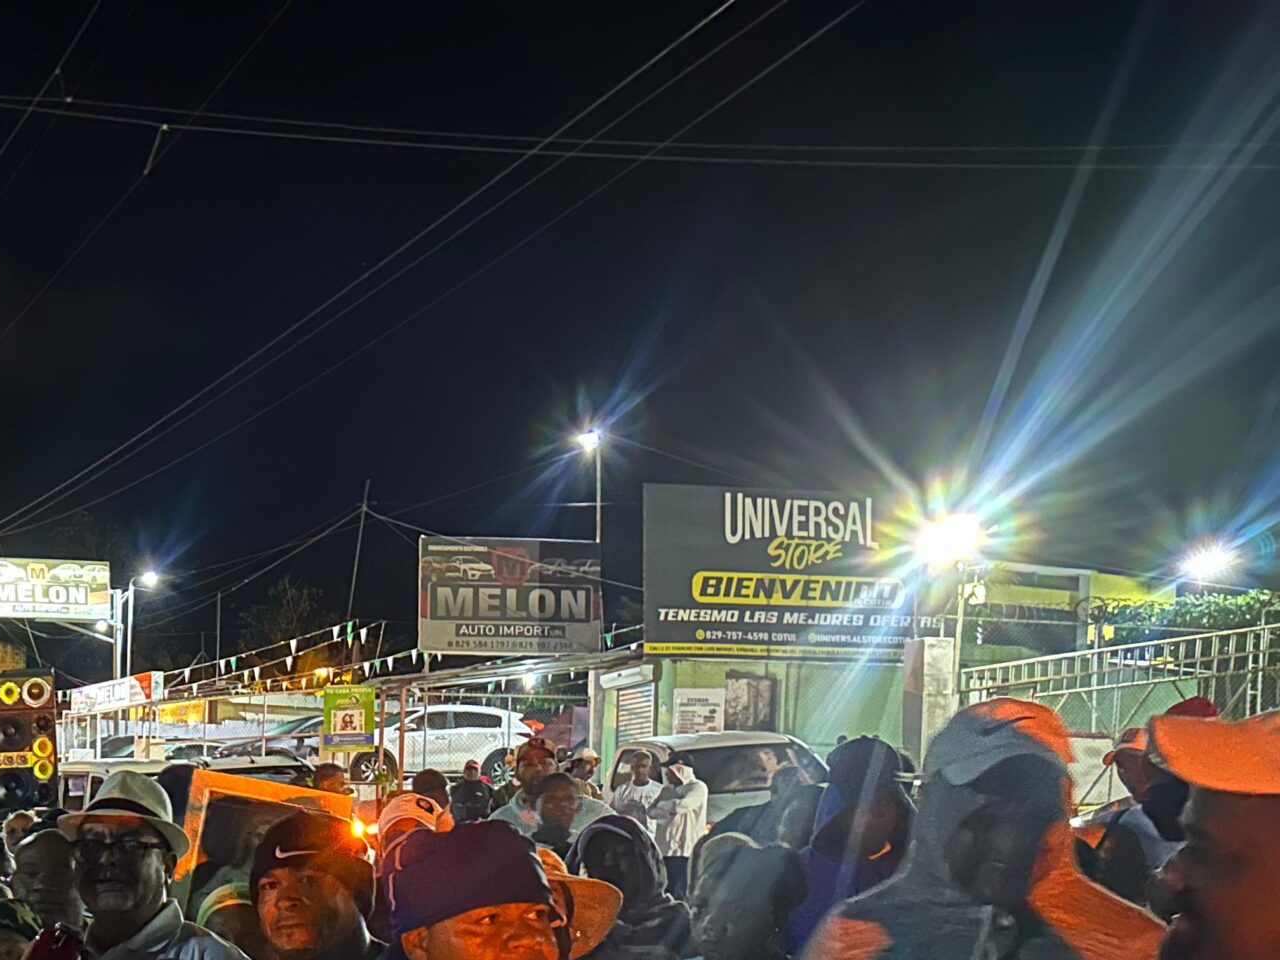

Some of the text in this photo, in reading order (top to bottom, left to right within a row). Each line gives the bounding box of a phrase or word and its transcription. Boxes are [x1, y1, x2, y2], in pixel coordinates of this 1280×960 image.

[724, 492, 879, 550] UNIVERSAL
[767, 535, 843, 570] STORE
[436, 586, 587, 620] MELON
[658, 607, 738, 624] TENESMO
[743, 610, 778, 625] LAS
[782, 612, 864, 627] MEJORES
[459, 624, 496, 636] AUTO
[499, 624, 550, 637] IMPORT
